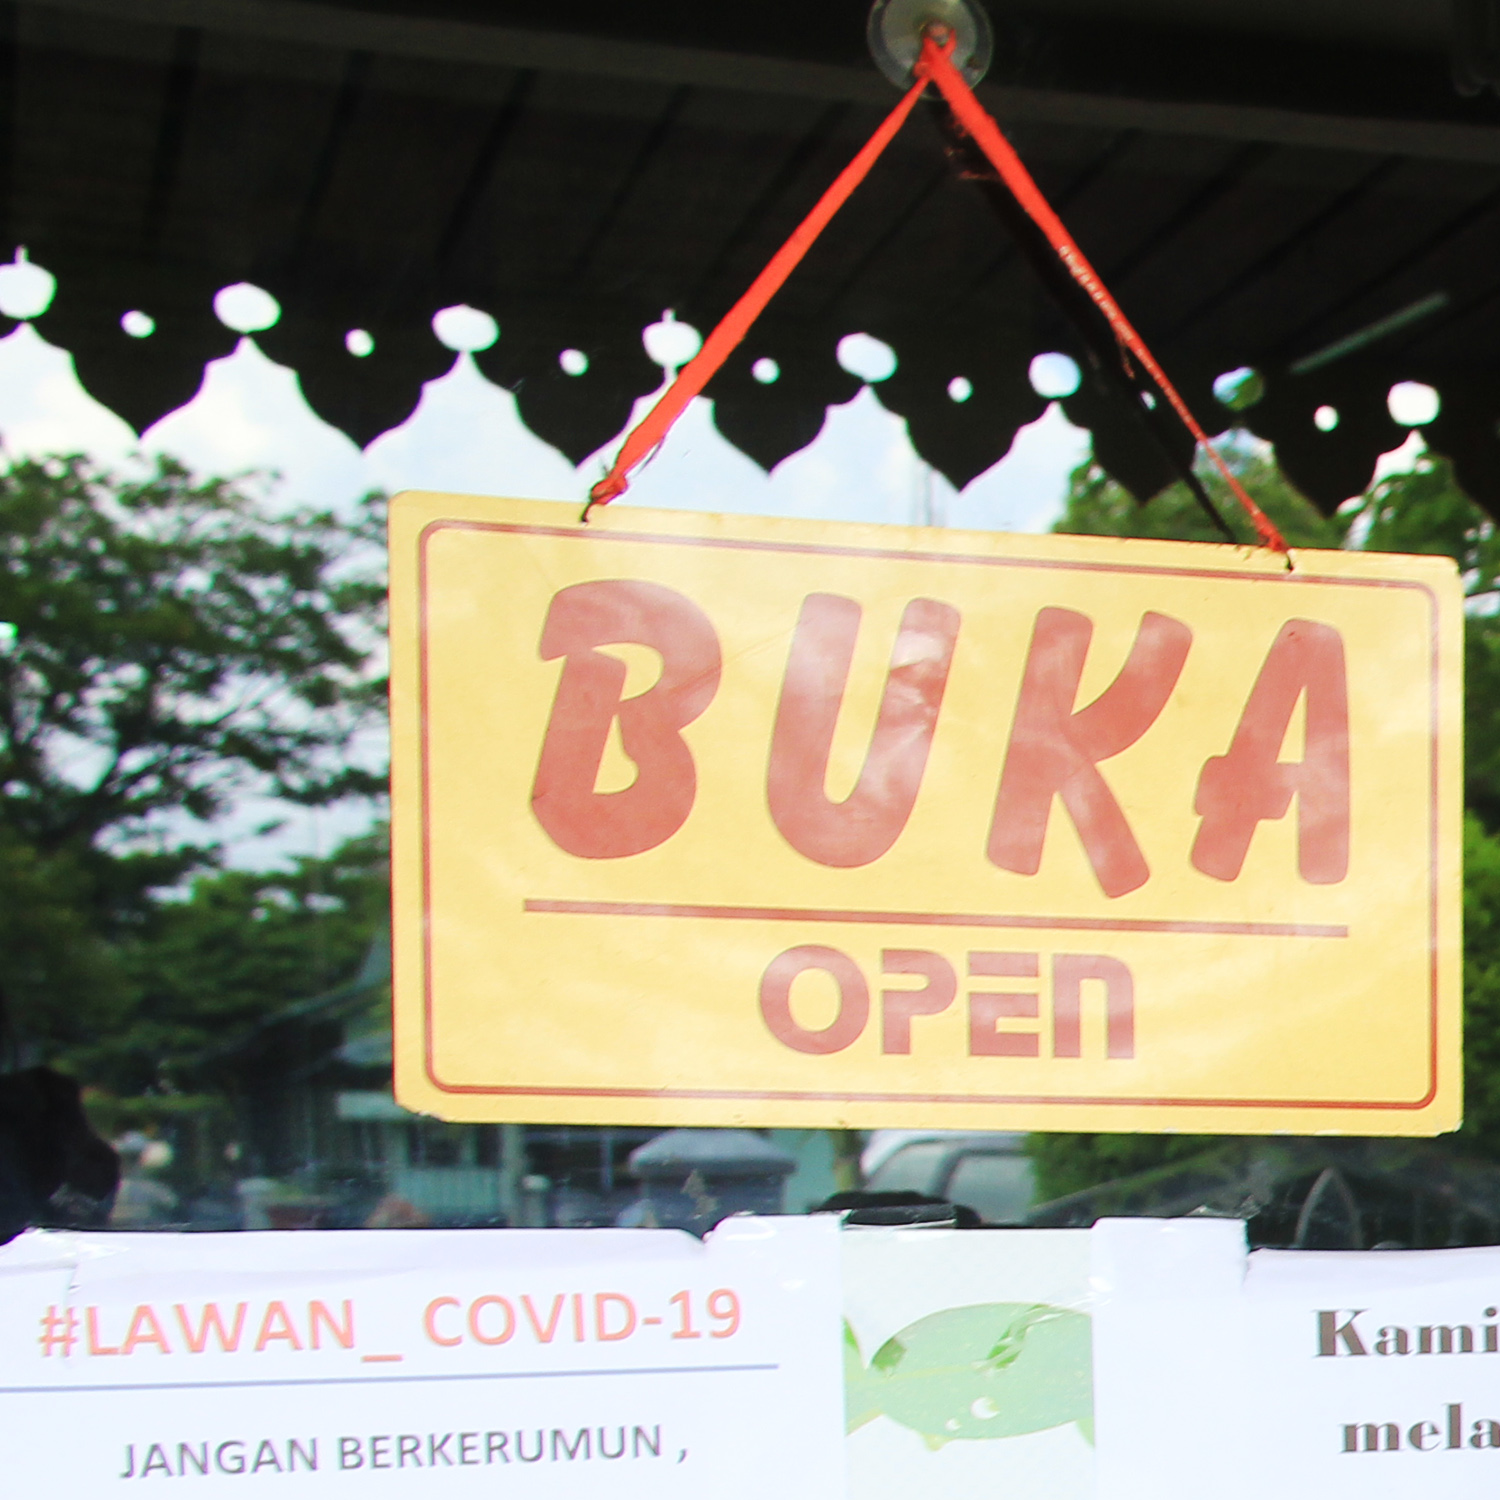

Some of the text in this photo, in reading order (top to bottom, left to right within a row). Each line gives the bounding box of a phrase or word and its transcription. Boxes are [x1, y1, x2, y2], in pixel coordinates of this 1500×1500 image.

[530, 577, 1350, 898] BUKA
[758, 942, 1137, 1060] OPEN
[422, 1286, 744, 1348] COVID-19
[119, 1436, 319, 1481] JANGAN
[337, 1424, 663, 1471] BERKERUMUN
